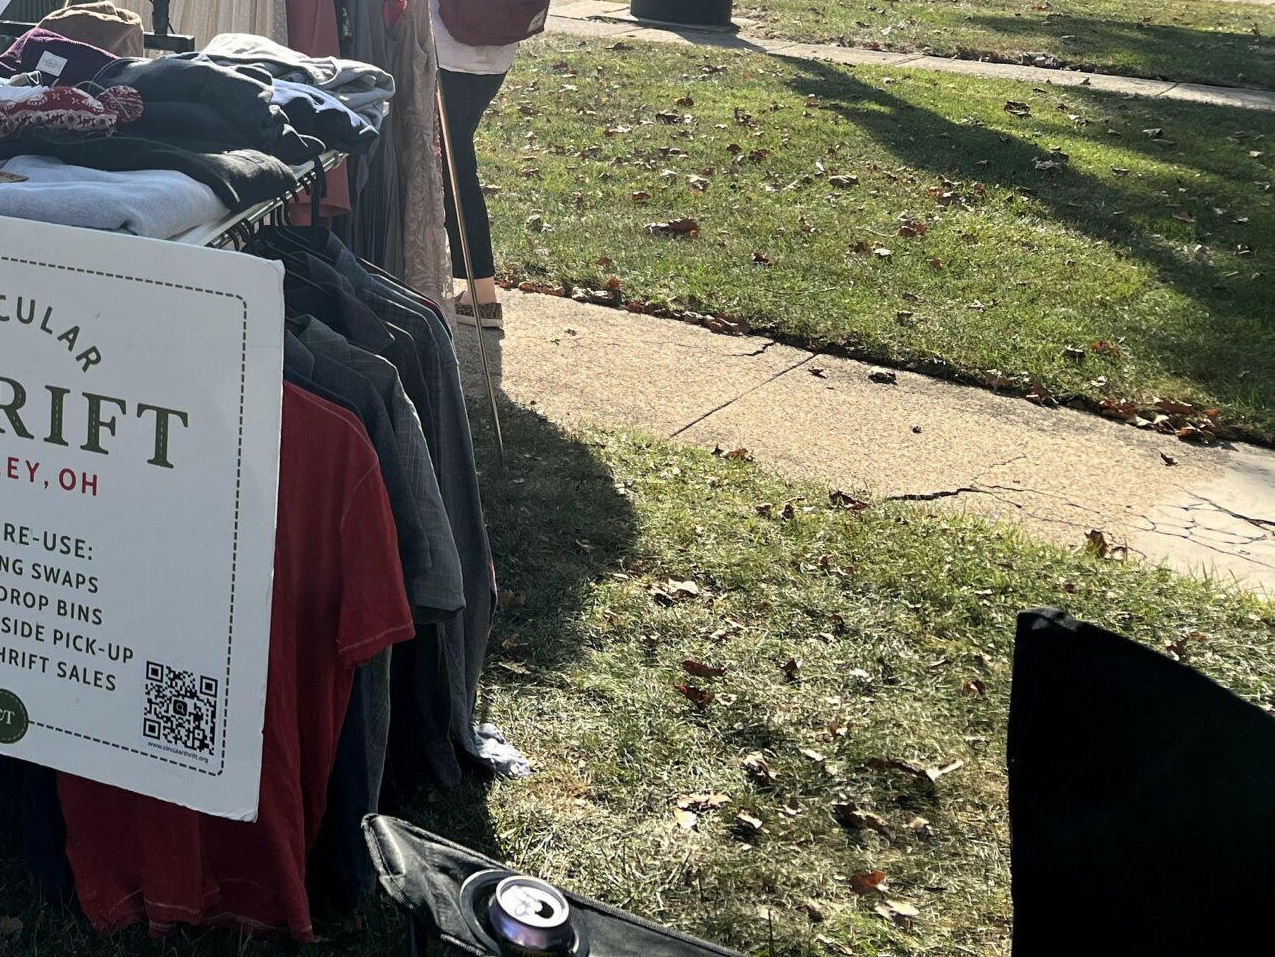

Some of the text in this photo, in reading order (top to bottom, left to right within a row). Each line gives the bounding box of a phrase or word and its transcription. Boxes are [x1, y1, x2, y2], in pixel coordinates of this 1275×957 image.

[59, 468, 97, 496] OH
[4, 523, 92, 560] RE-USE:
[32, 563, 98, 593] SWAPS
[57, 600, 102, 625] BINS
[53, 629, 133, 663] PICK-UP
[57, 662, 115, 691] SALES
[147, 741, 209, 764] www.circularthrift.org
